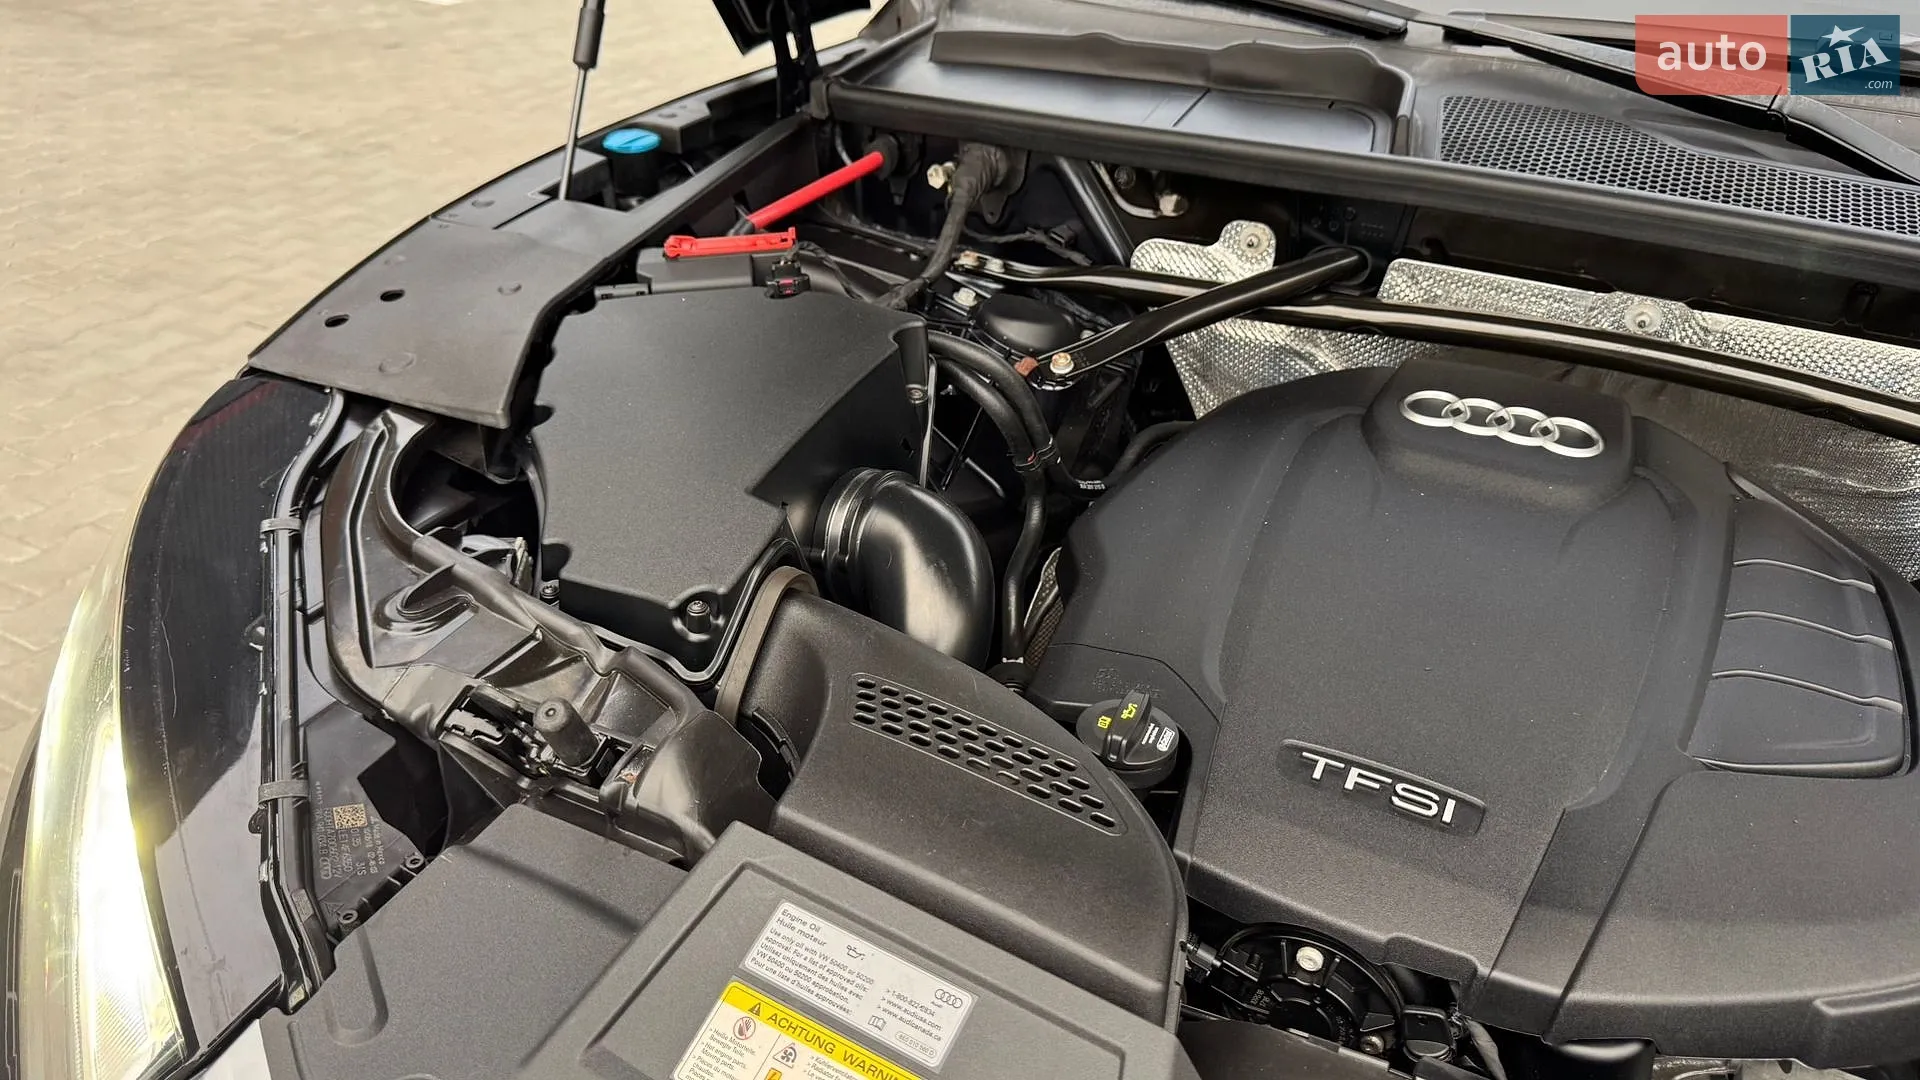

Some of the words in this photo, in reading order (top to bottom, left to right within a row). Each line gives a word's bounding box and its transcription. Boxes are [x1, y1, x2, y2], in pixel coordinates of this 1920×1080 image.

[1302, 752, 1456, 823] TFSI
[775, 917, 796, 931] Huile
[796, 928, 827, 947] moteur
[780, 908, 808, 927] Engine
[808, 922, 821, 933] Oil
[750, 956, 765, 968] Pour
[765, 965, 777, 974] une
[776, 970, 791, 981] liste
[754, 949, 767, 959] VW
[766, 955, 785, 968] 50400
[784, 965, 793, 973] ou
[793, 969, 812, 983] 50200
[759, 942, 782, 957] Utilisez
[780, 953, 818, 976] uniquement
[817, 972, 829, 981] des
[828, 978, 848, 992] huiles
[847, 989, 864, 1000] avec
[769, 927, 781, 937] Use
[780, 933, 795, 944] only
[794, 940, 804, 948] oil
[804, 945, 818, 955] with
[817, 952, 829, 961] VW
[828, 958, 848, 971] 50400
[855, 971, 874, 985] 50200
[792, 949, 803, 958] For
[807, 957, 819, 966] list
[818, 962, 826, 970] of
[825, 966, 855, 986] approved
[881, 1005, 943, 1041] www.audicanada.ca
[885, 998, 942, 1031] www.audiusa.com
[708, 1034, 732, 1050] Bewegte
[766, 1011, 837, 1054] ACHTUNG
[699, 1047, 721, 1063] Moving
[704, 1042, 715, 1051] Hot
[713, 1048, 732, 1061] engine
[713, 1064, 721, 1072] du
